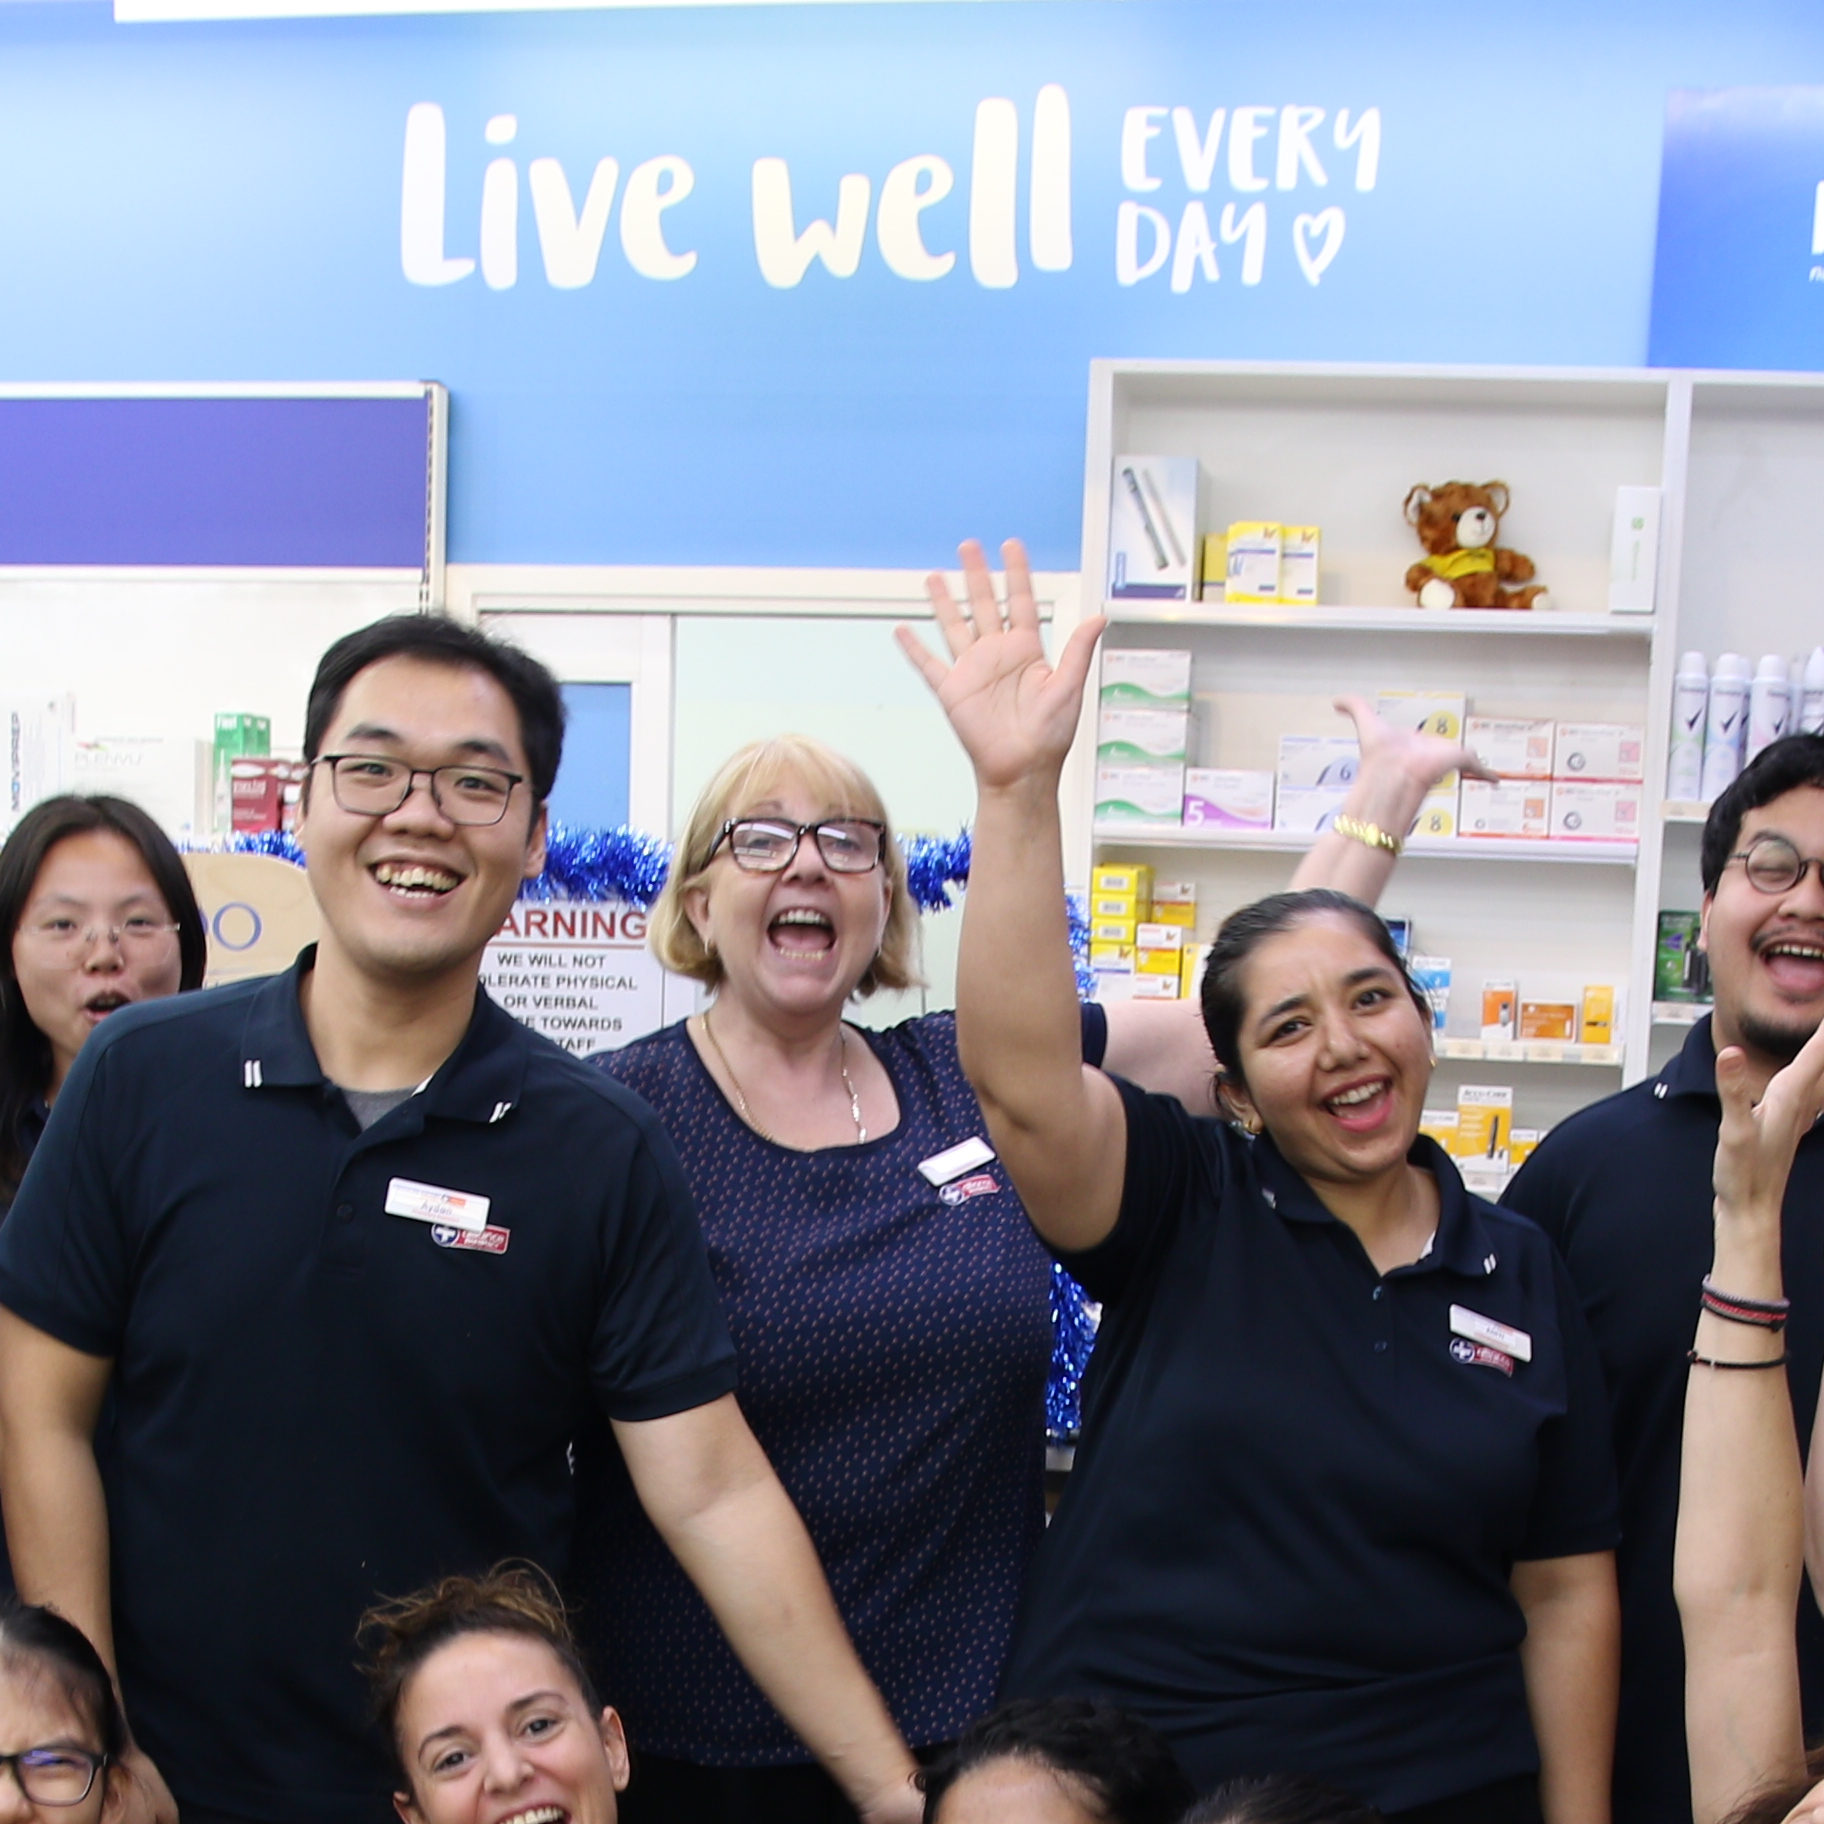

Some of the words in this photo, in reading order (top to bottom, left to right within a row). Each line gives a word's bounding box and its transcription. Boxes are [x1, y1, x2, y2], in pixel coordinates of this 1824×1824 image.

[1120, 104, 1382, 194] EVERY
[400, 100, 699, 291] Live
[750, 82, 1074, 290] well
[1115, 199, 1268, 294] DAY
[10, 711, 22, 813] MOVIPREP
[1186, 797, 1205, 827] 5
[497, 909, 647, 940] ARNING
[498, 952, 524, 968] WE
[529, 953, 567, 969] WILL
[573, 953, 607, 969] NOT
[478, 972, 551, 989] OLERATE
[556, 974, 638, 991] PHYSICAL
[503, 994, 528, 1010] OR
[532, 995, 599, 1010] VERBAL
[541, 1016, 623, 1031] TOWARDS
[421, 1201, 453, 1217] Aydan
